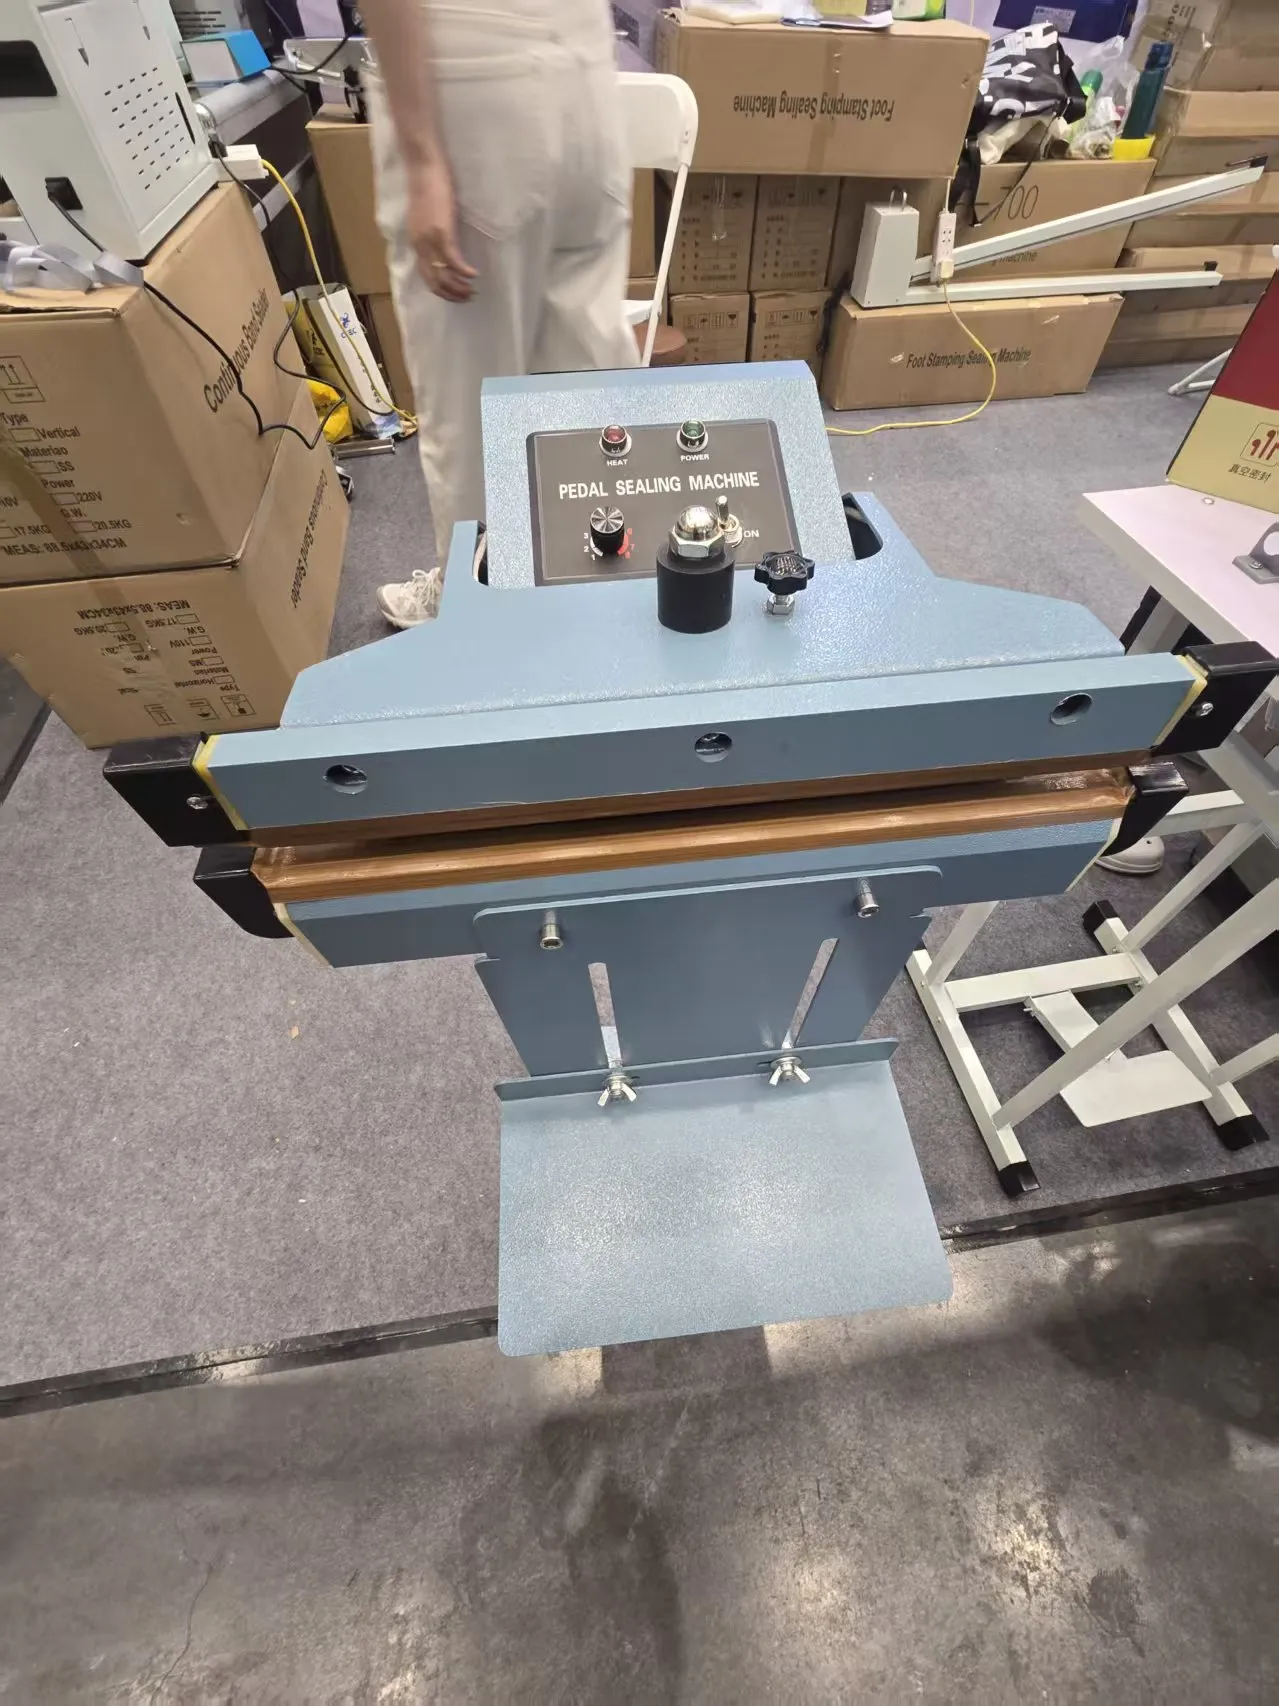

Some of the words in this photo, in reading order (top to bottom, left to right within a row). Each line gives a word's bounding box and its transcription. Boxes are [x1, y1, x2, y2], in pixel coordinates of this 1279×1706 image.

[733, 95, 777, 119] Machine
[779, 90, 818, 119] Sealing
[820, 92, 868, 120] Stamping
[870, 98, 895, 121] Foot
[906, 353, 927, 368] Foot
[926, 351, 965, 368] Stamping
[998, 347, 1032, 364] Machine
[2, 412, 29, 426] Type
[38, 426, 81, 440] Vertical
[1228, 463, 1272, 484] 真空密封
[41, 479, 75, 489] Power
[559, 482, 608, 500] PEDAL
[615, 476, 681, 496] SEALING
[689, 471, 760, 491] MACHINE
[78, 491, 103, 503] 220V
[14, 525, 51, 537] 17.5KG
[743, 530, 759, 538] ON
[1, 543, 44, 557] MEAS:
[154, 600, 191, 612] MEAS:
[191, 647, 218, 655] Power
[219, 684, 240, 692] Type
